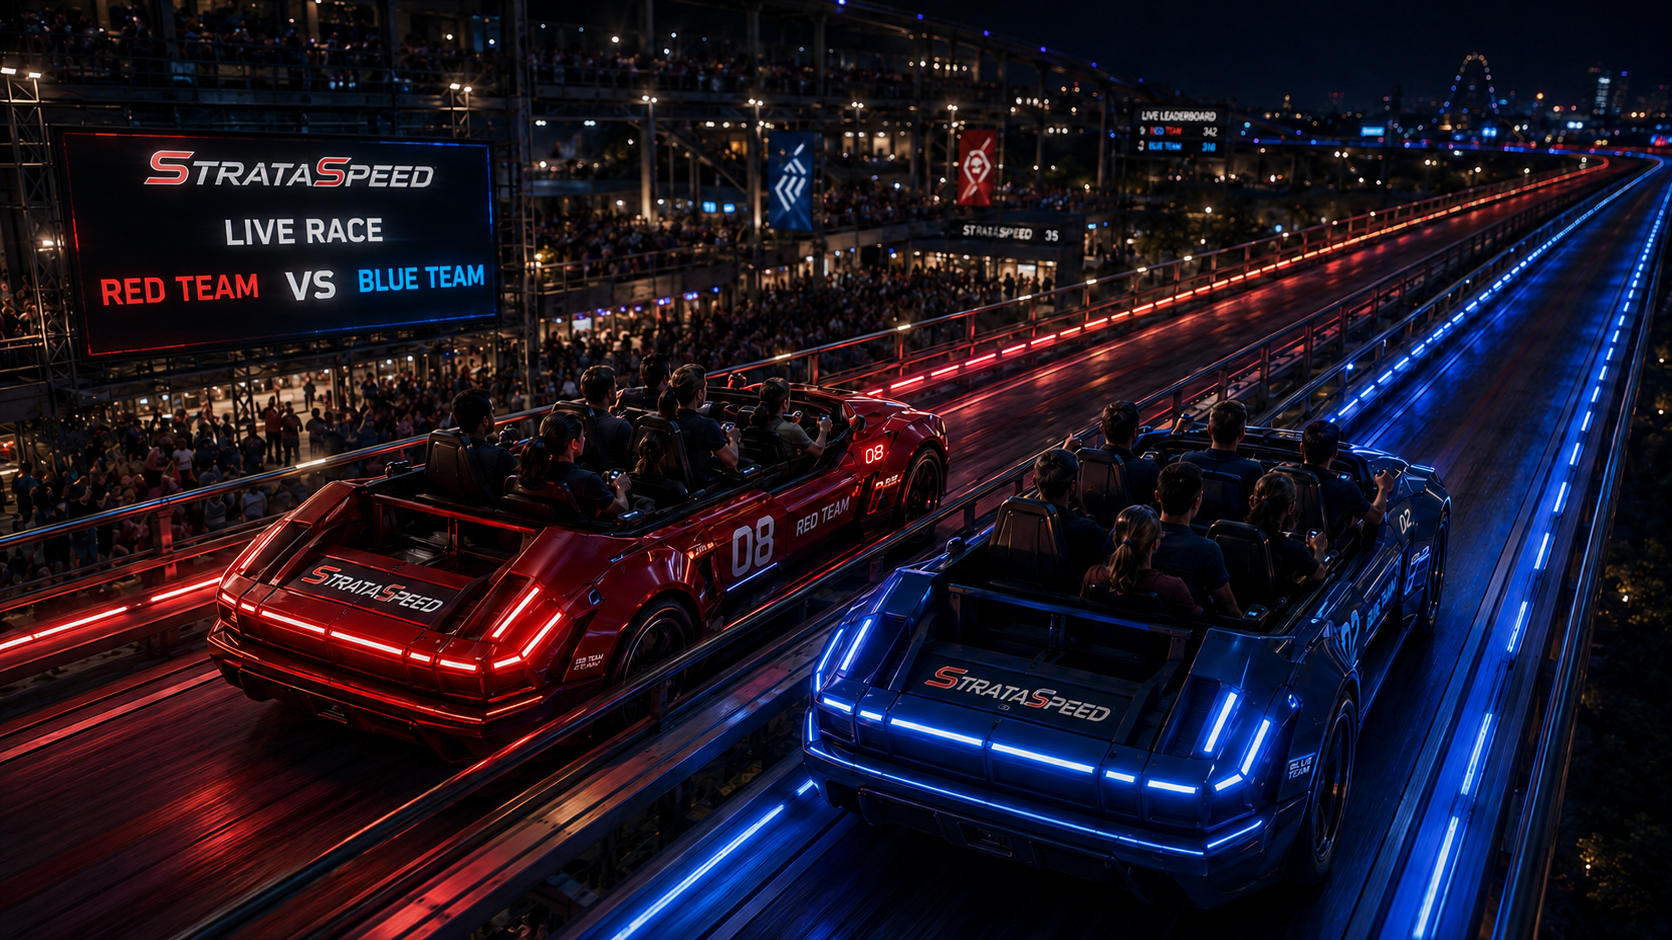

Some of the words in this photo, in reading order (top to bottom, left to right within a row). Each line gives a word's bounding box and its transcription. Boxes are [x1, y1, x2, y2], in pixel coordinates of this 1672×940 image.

[1141, 111, 1159, 121] LIVE
[1160, 111, 1217, 122] LEADERBOARD
[1203, 126, 1218, 137] 342
[144, 150, 434, 188] STRATASPEED
[225, 218, 295, 246] LIVE
[306, 218, 383, 244] RACE
[1045, 229, 1059, 242] 35
[101, 277, 166, 306] RED
[176, 273, 259, 302] TEAM
[285, 270, 337, 301] VS
[358, 267, 419, 293] BLUE
[425, 264, 485, 289] TEAM
[865, 444, 884, 464] 08
[796, 512, 818, 537] RED
[821, 496, 850, 524] TEAM
[731, 514, 775, 578] 08
[301, 565, 444, 613] STRATASPEED
[924, 665, 1111, 722] STRATASPEED
